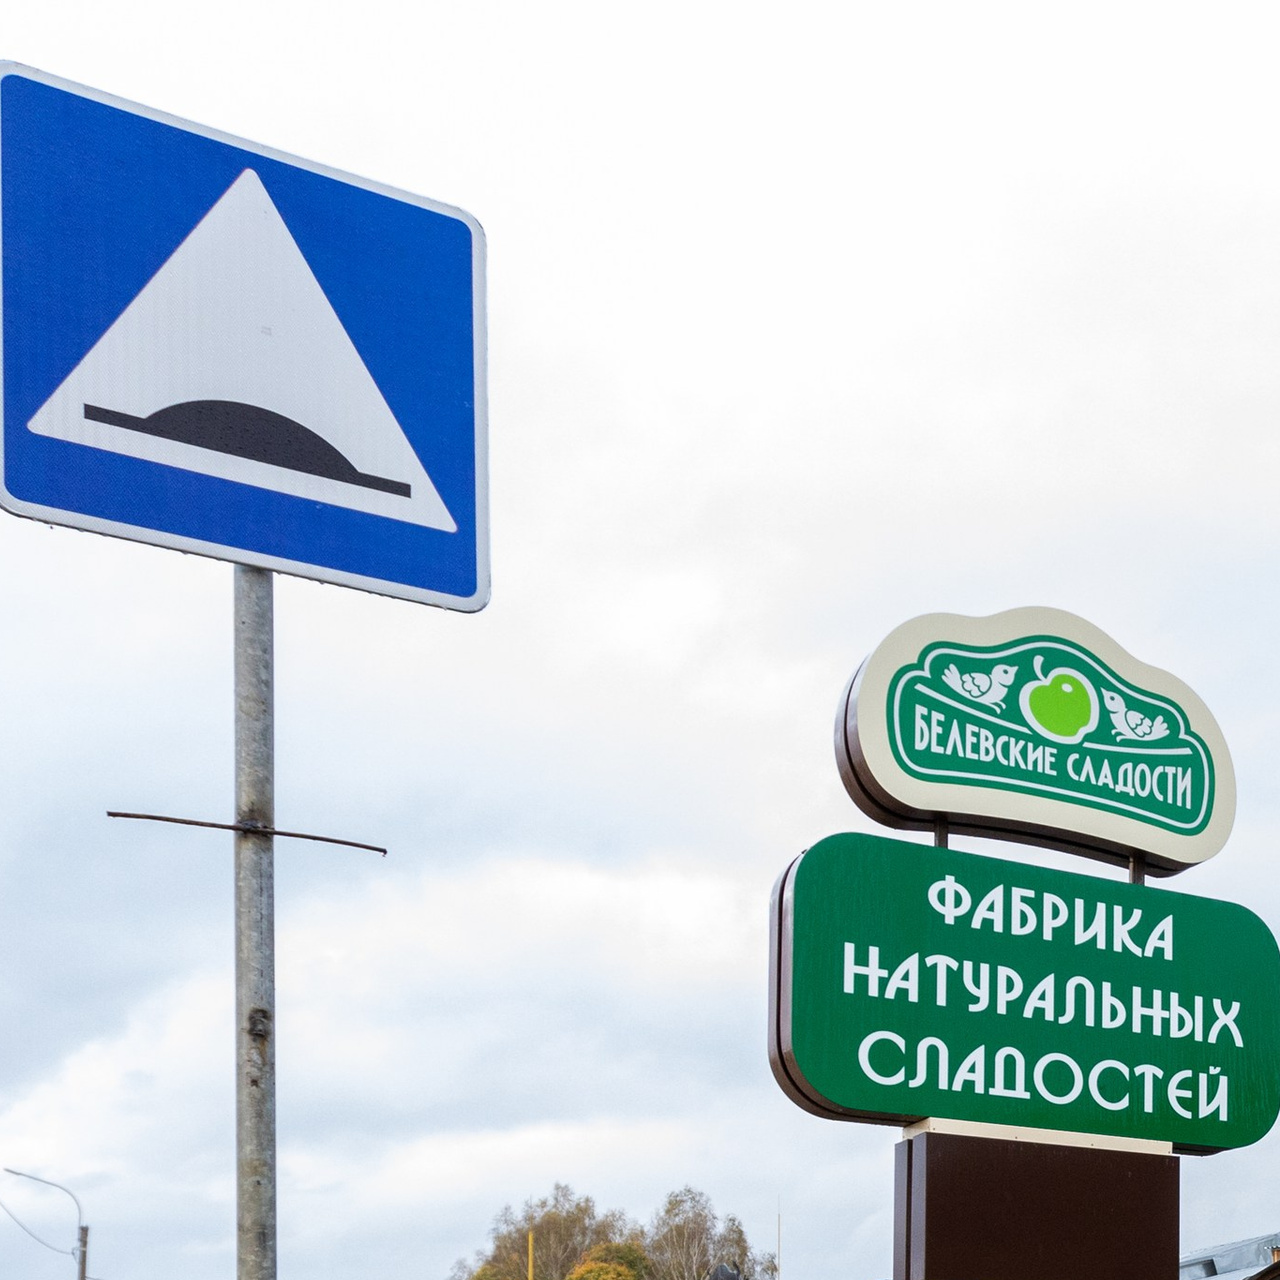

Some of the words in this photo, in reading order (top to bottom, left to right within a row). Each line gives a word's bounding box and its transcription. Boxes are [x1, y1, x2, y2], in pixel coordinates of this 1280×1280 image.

[914, 704, 1058, 777] БЕЛЕВСКИЕ
[1066, 752, 1193, 810] СЛАДОСТИ
[927, 874, 1173, 961] ФАБРИКА
[843, 941, 1244, 1048] НАТУРАЛЬНЫХ
[857, 1030, 1228, 1122] СЛАДОСТЕЙ
